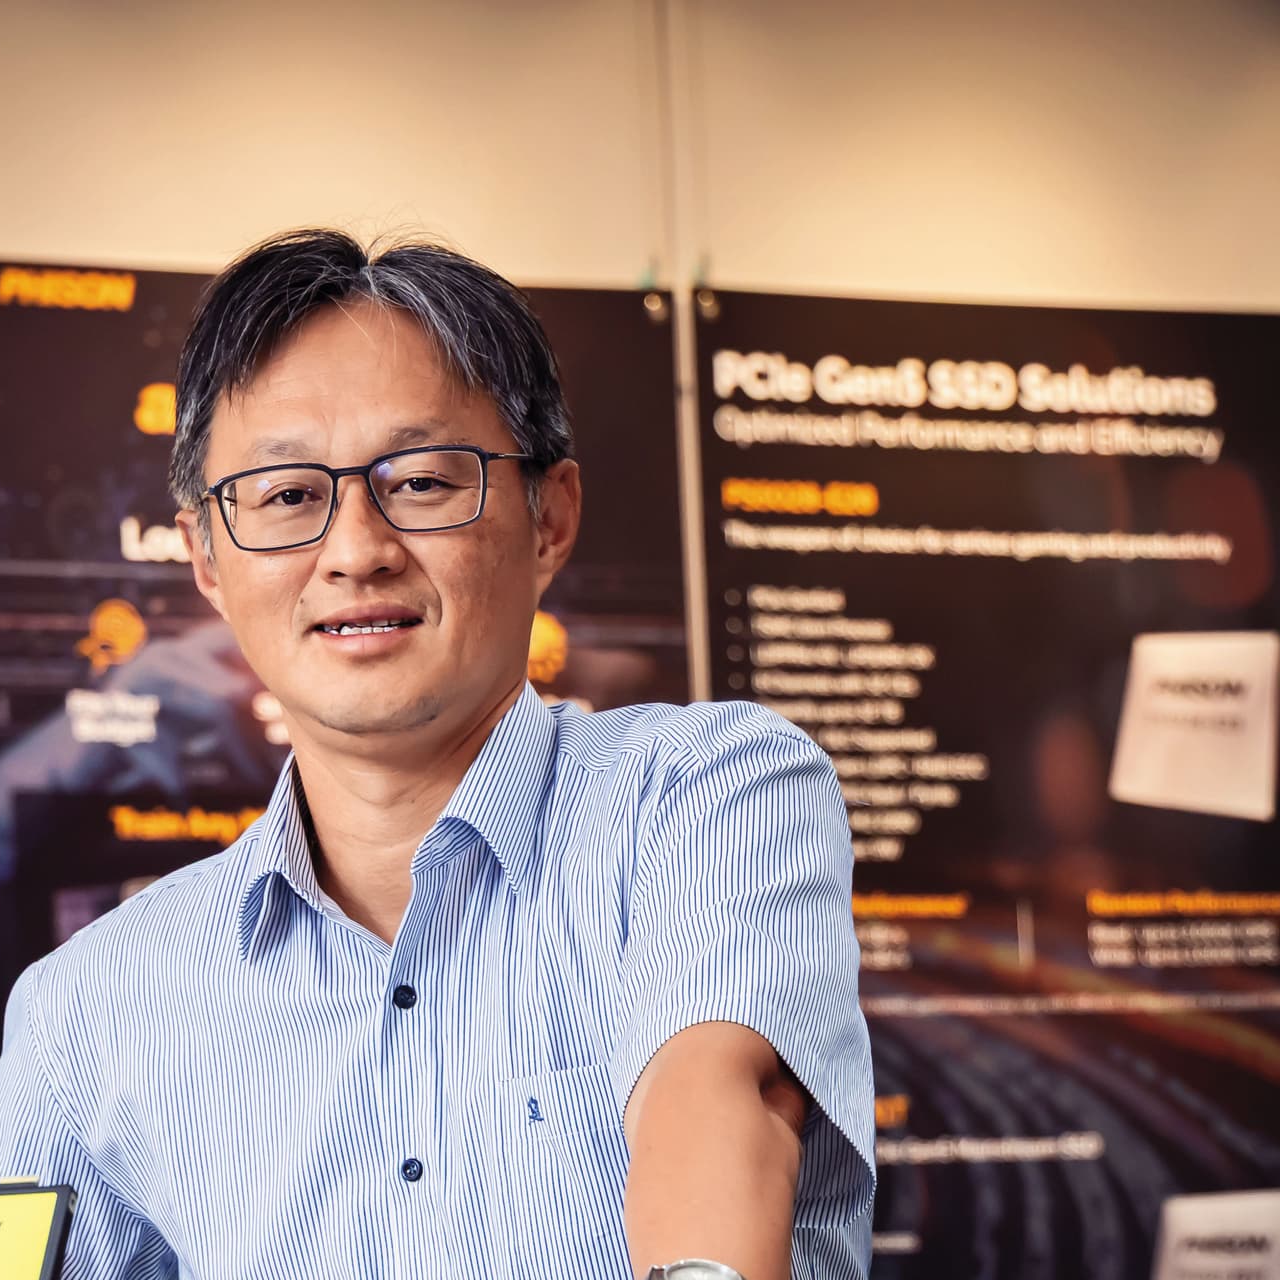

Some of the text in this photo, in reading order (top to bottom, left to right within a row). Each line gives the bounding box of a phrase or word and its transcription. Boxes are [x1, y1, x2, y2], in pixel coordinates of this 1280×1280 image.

[712, 348, 812, 403] PCIe
[927, 358, 1017, 412] SSD
[1018, 363, 1218, 418] Solutions
